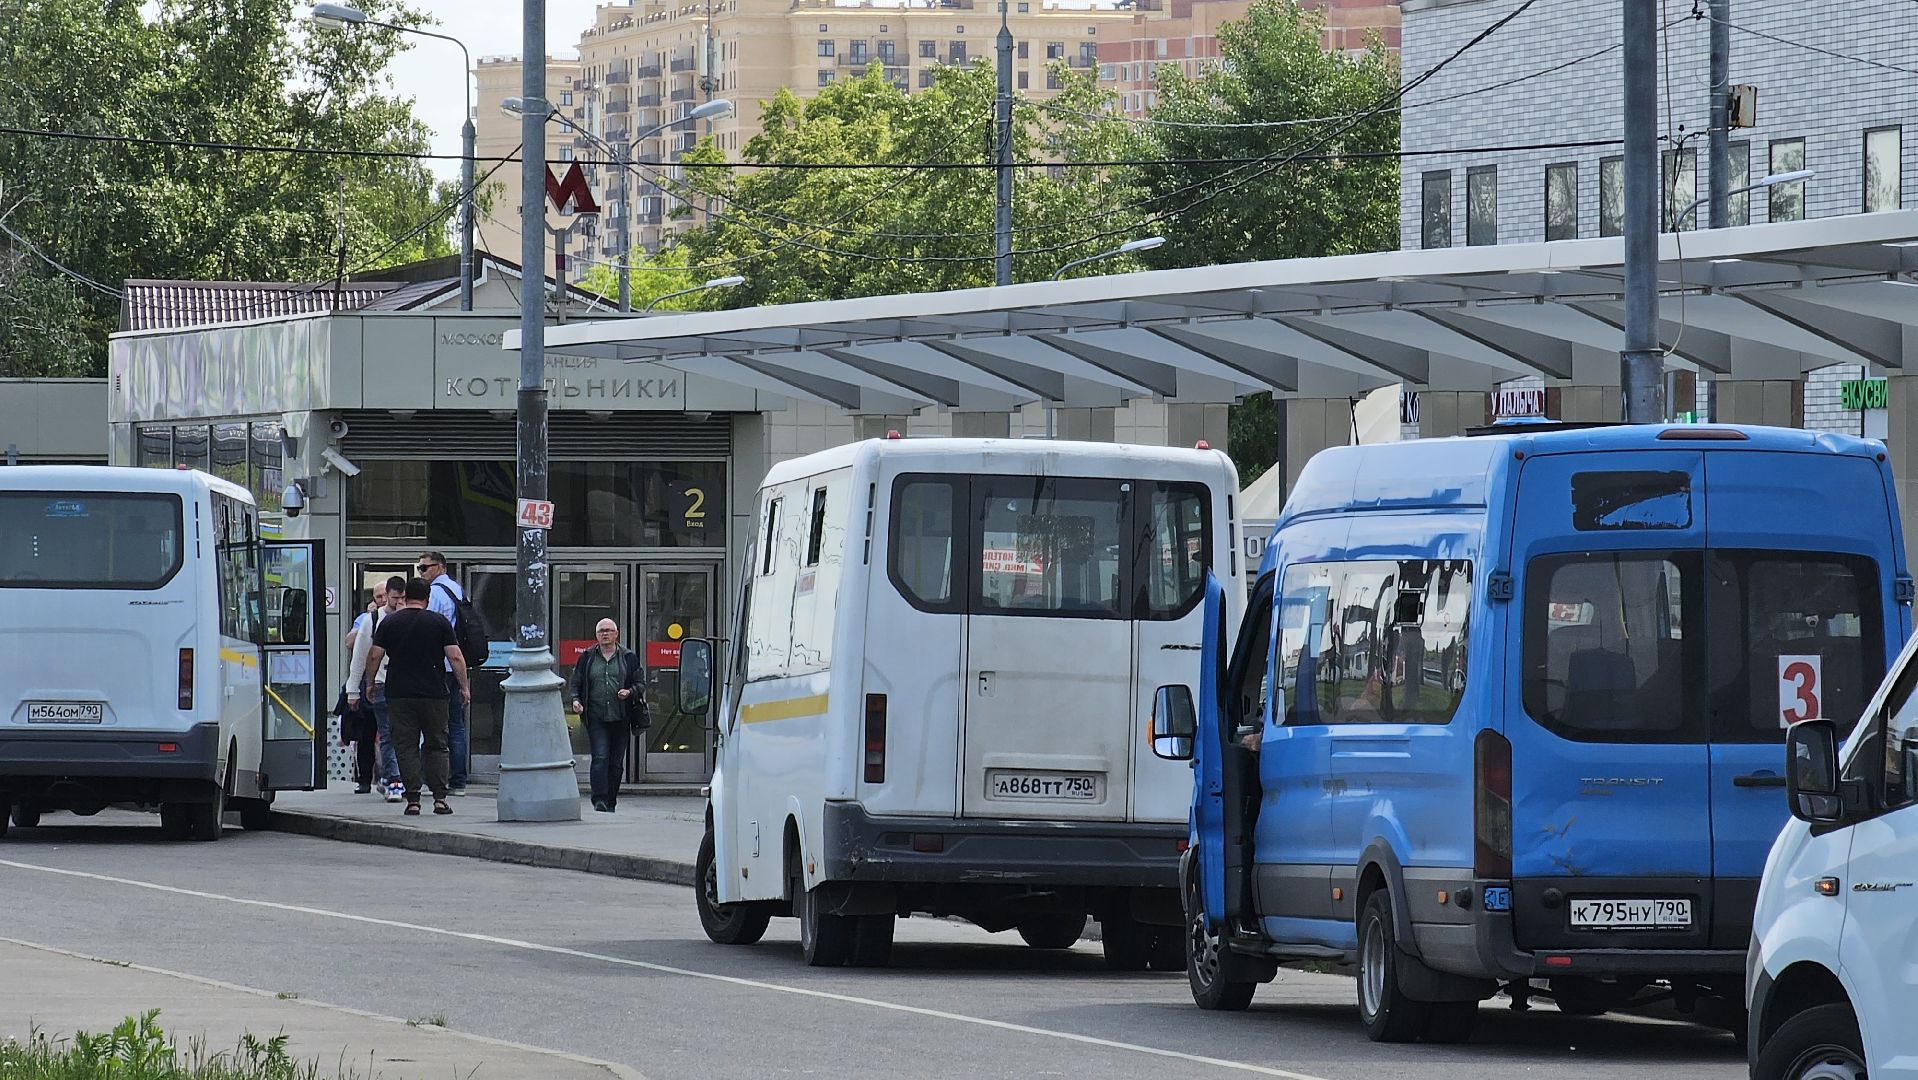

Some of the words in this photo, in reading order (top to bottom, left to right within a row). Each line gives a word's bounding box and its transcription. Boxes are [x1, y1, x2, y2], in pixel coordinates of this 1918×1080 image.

[446, 377, 676, 397] КОТЛЬНИКИ
[1841, 380, 1888, 409] ВКУСВИ
[1490, 391, 1498, 416] У
[1499, 390, 1540, 415] ПАЛЫЧА
[684, 488, 706, 518] 2
[521, 503, 551, 526] 43
[686, 520, 704, 528] Вход
[1783, 662, 1819, 725] 3
[32, 706, 78, 718] М564ОМ
[80, 705, 98, 715] 790
[999, 778, 1063, 795] А868ТТ
[1065, 778, 1092, 791] 750
[1580, 777, 1664, 786] TRANSIT
[1578, 903, 1651, 922] К795НУ
[1656, 902, 1685, 916] 790
